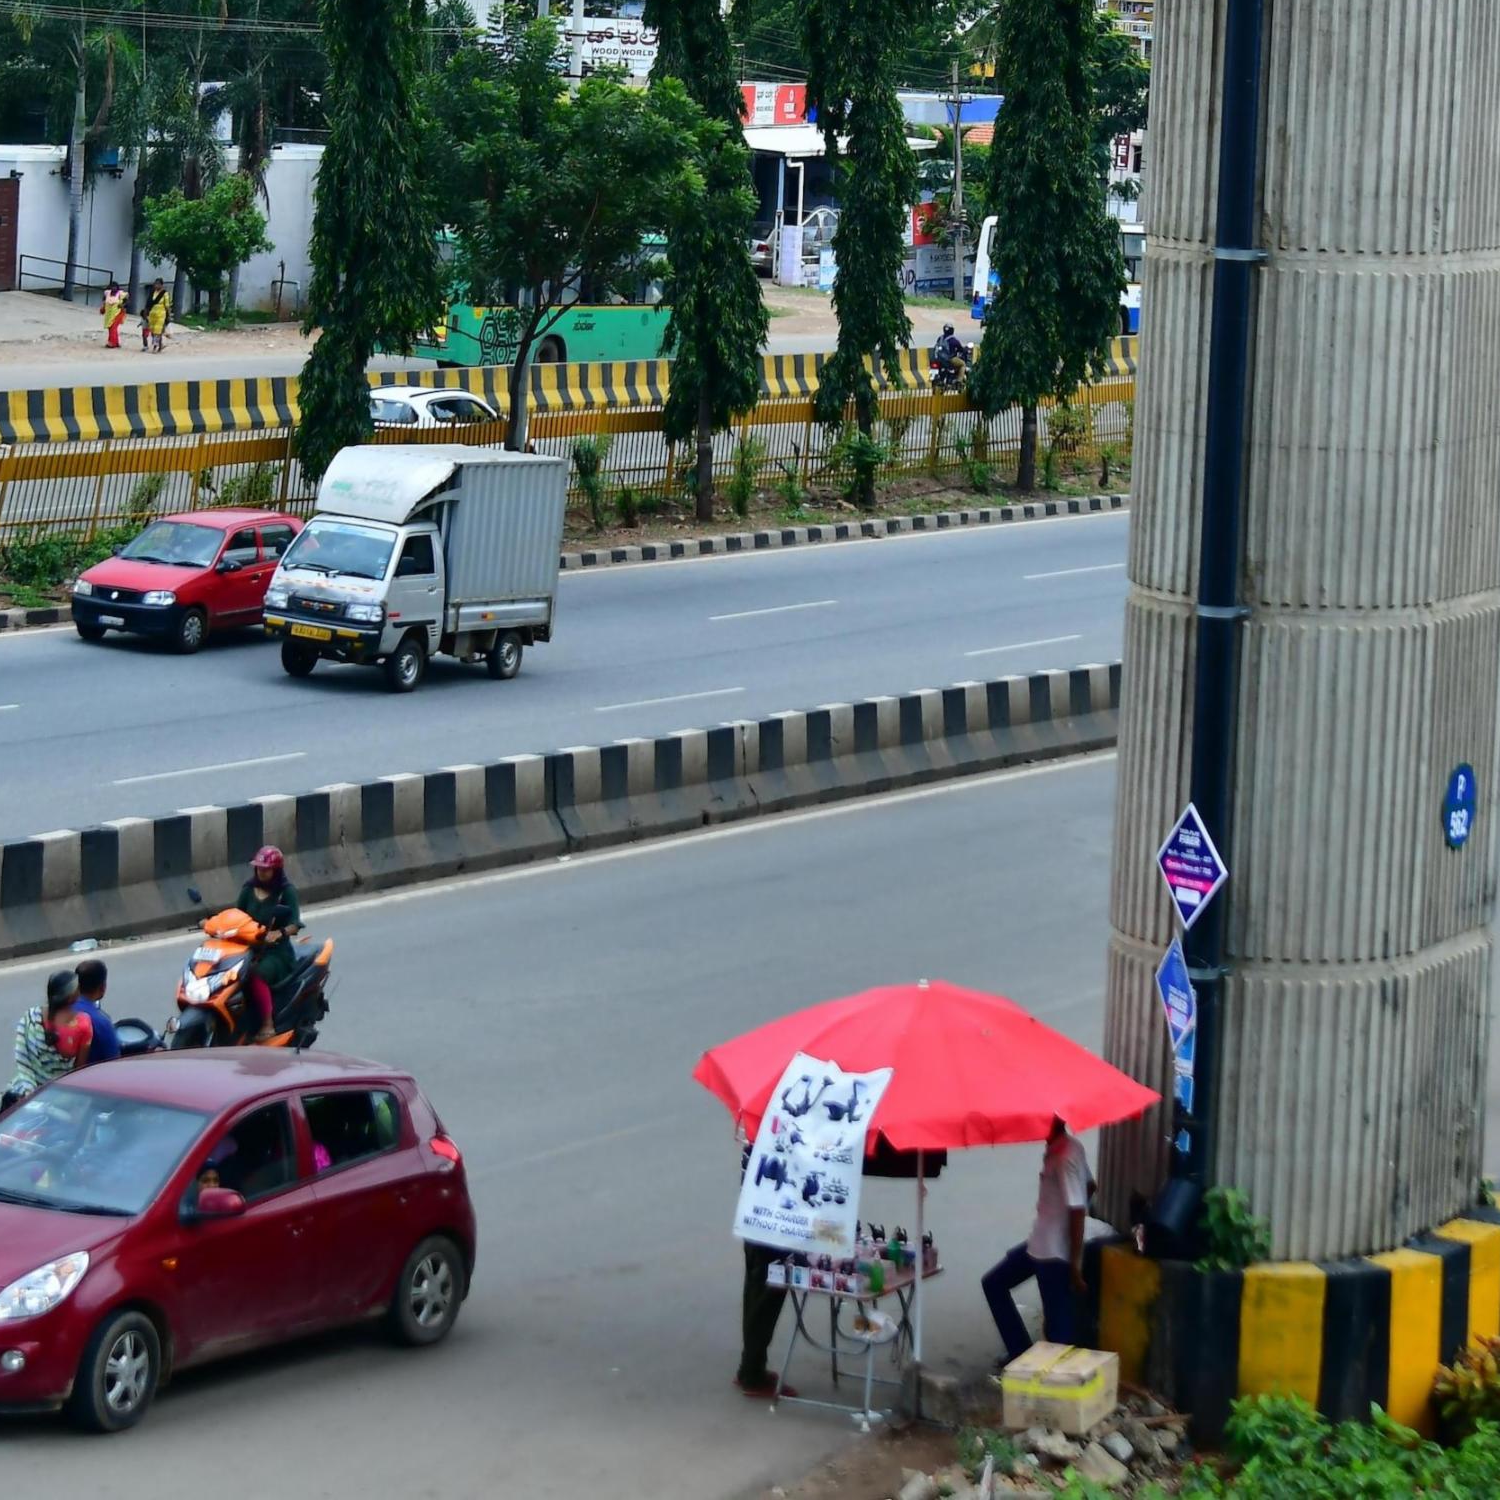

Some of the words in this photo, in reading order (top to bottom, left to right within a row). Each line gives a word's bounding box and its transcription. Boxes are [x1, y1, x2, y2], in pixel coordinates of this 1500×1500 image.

[592, 47, 619, 55] WOOD
[621, 48, 654, 57] WORLD
[1457, 774, 1467, 800] P
[752, 1205, 772, 1218] WITH
[743, 1215, 778, 1232] WITHOUT
